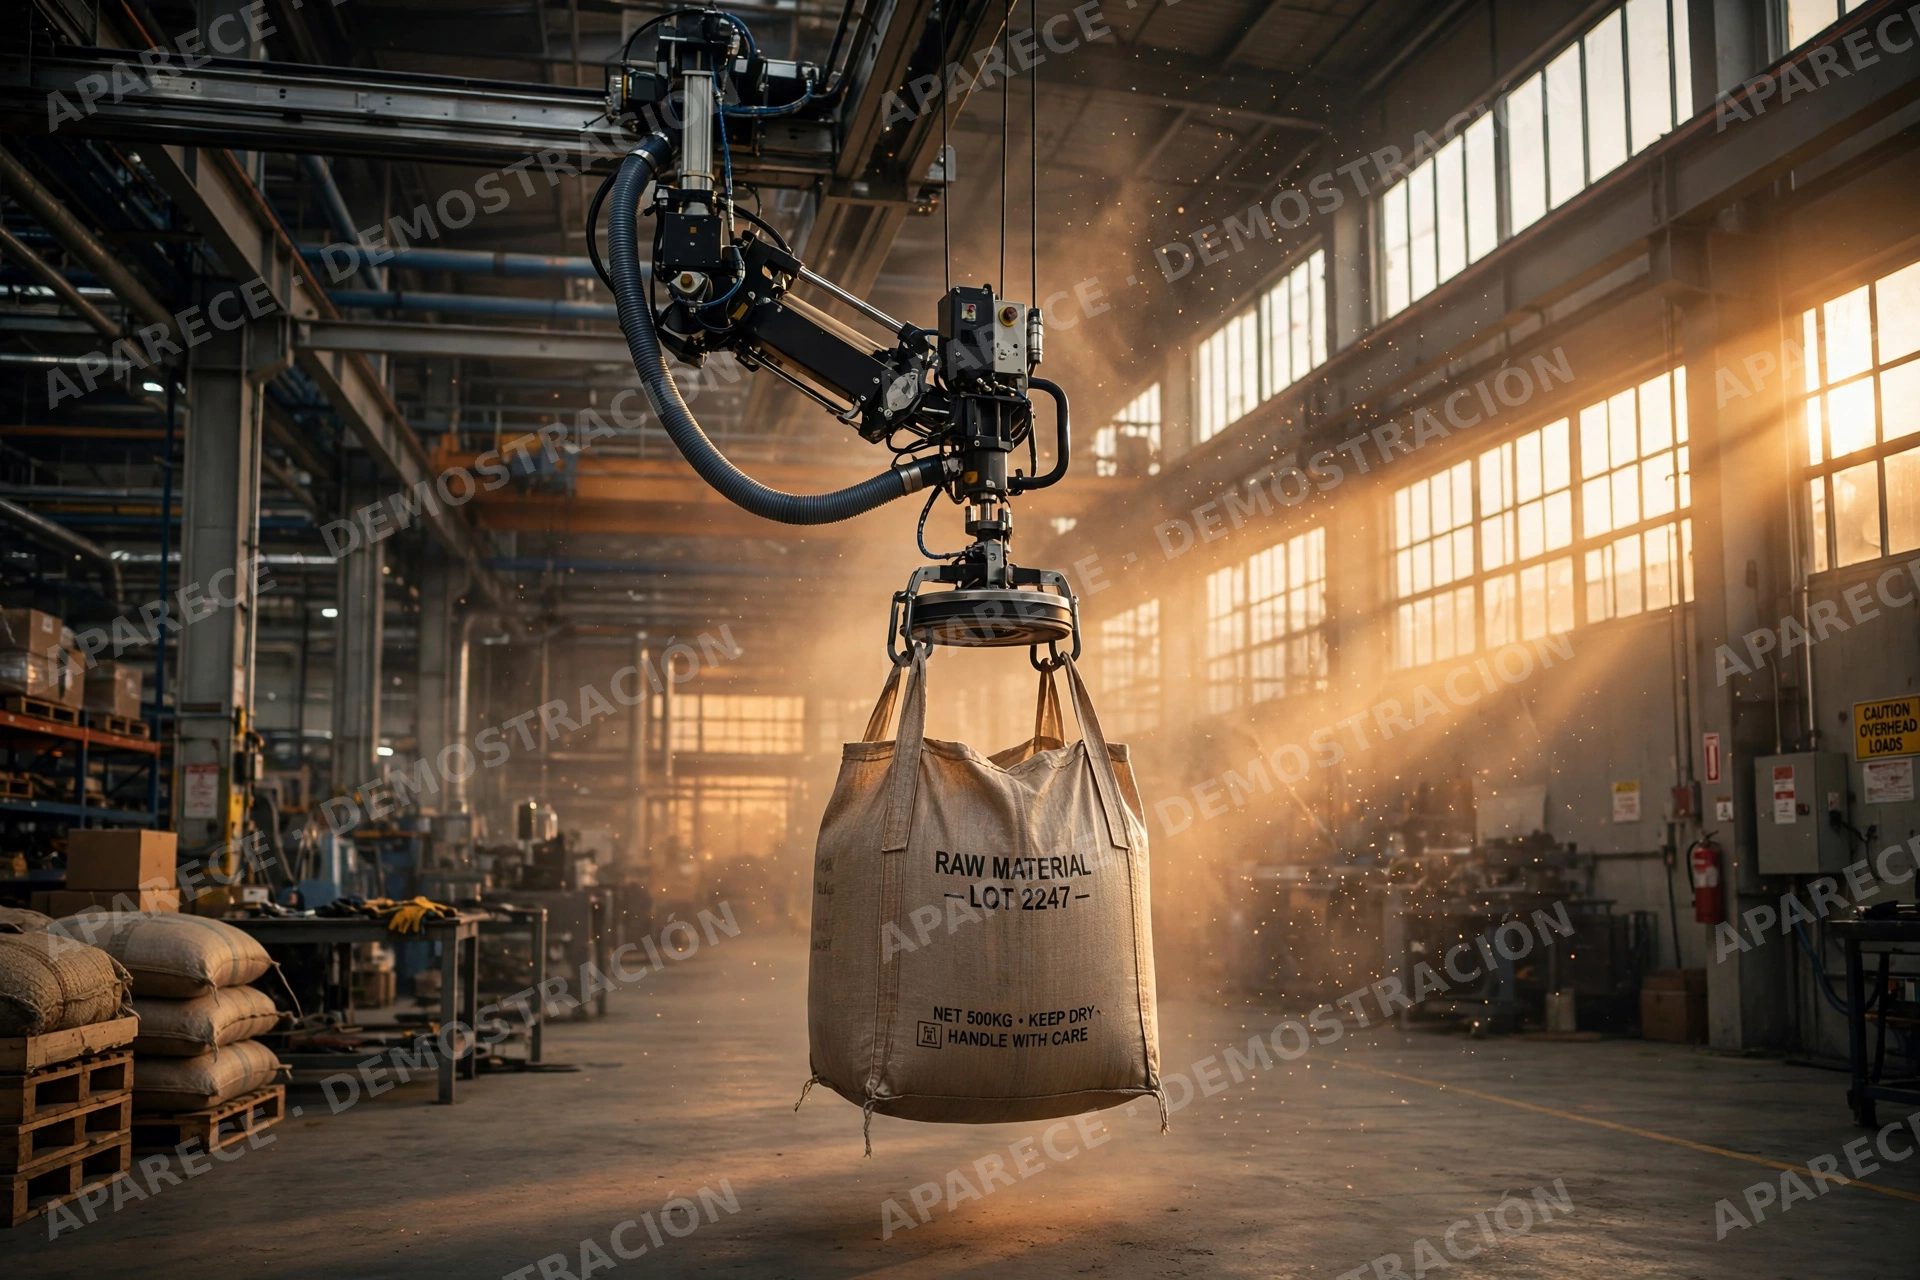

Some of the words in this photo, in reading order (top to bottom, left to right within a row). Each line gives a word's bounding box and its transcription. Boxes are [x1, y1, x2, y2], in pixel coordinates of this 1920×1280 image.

[1864, 703, 1910, 721] CAUTION
[1860, 718, 1918, 737] OVERHEAD
[1869, 737, 1903, 753] LOADS
[935, 850, 986, 877] RAW
[992, 853, 1092, 880] MATERIAL
[969, 884, 1015, 911] LOT
[1021, 886, 1071, 911] 2247
[933, 1006, 963, 1023] NET
[967, 1011, 1013, 1028] 500KG
[1028, 1010, 1066, 1027] KEEP
[1069, 1005, 1095, 1023] DRY
[948, 1028, 1008, 1048] HANDLE
[1012, 1032, 1047, 1048] WITH
[1052, 1027, 1089, 1046] CARE
